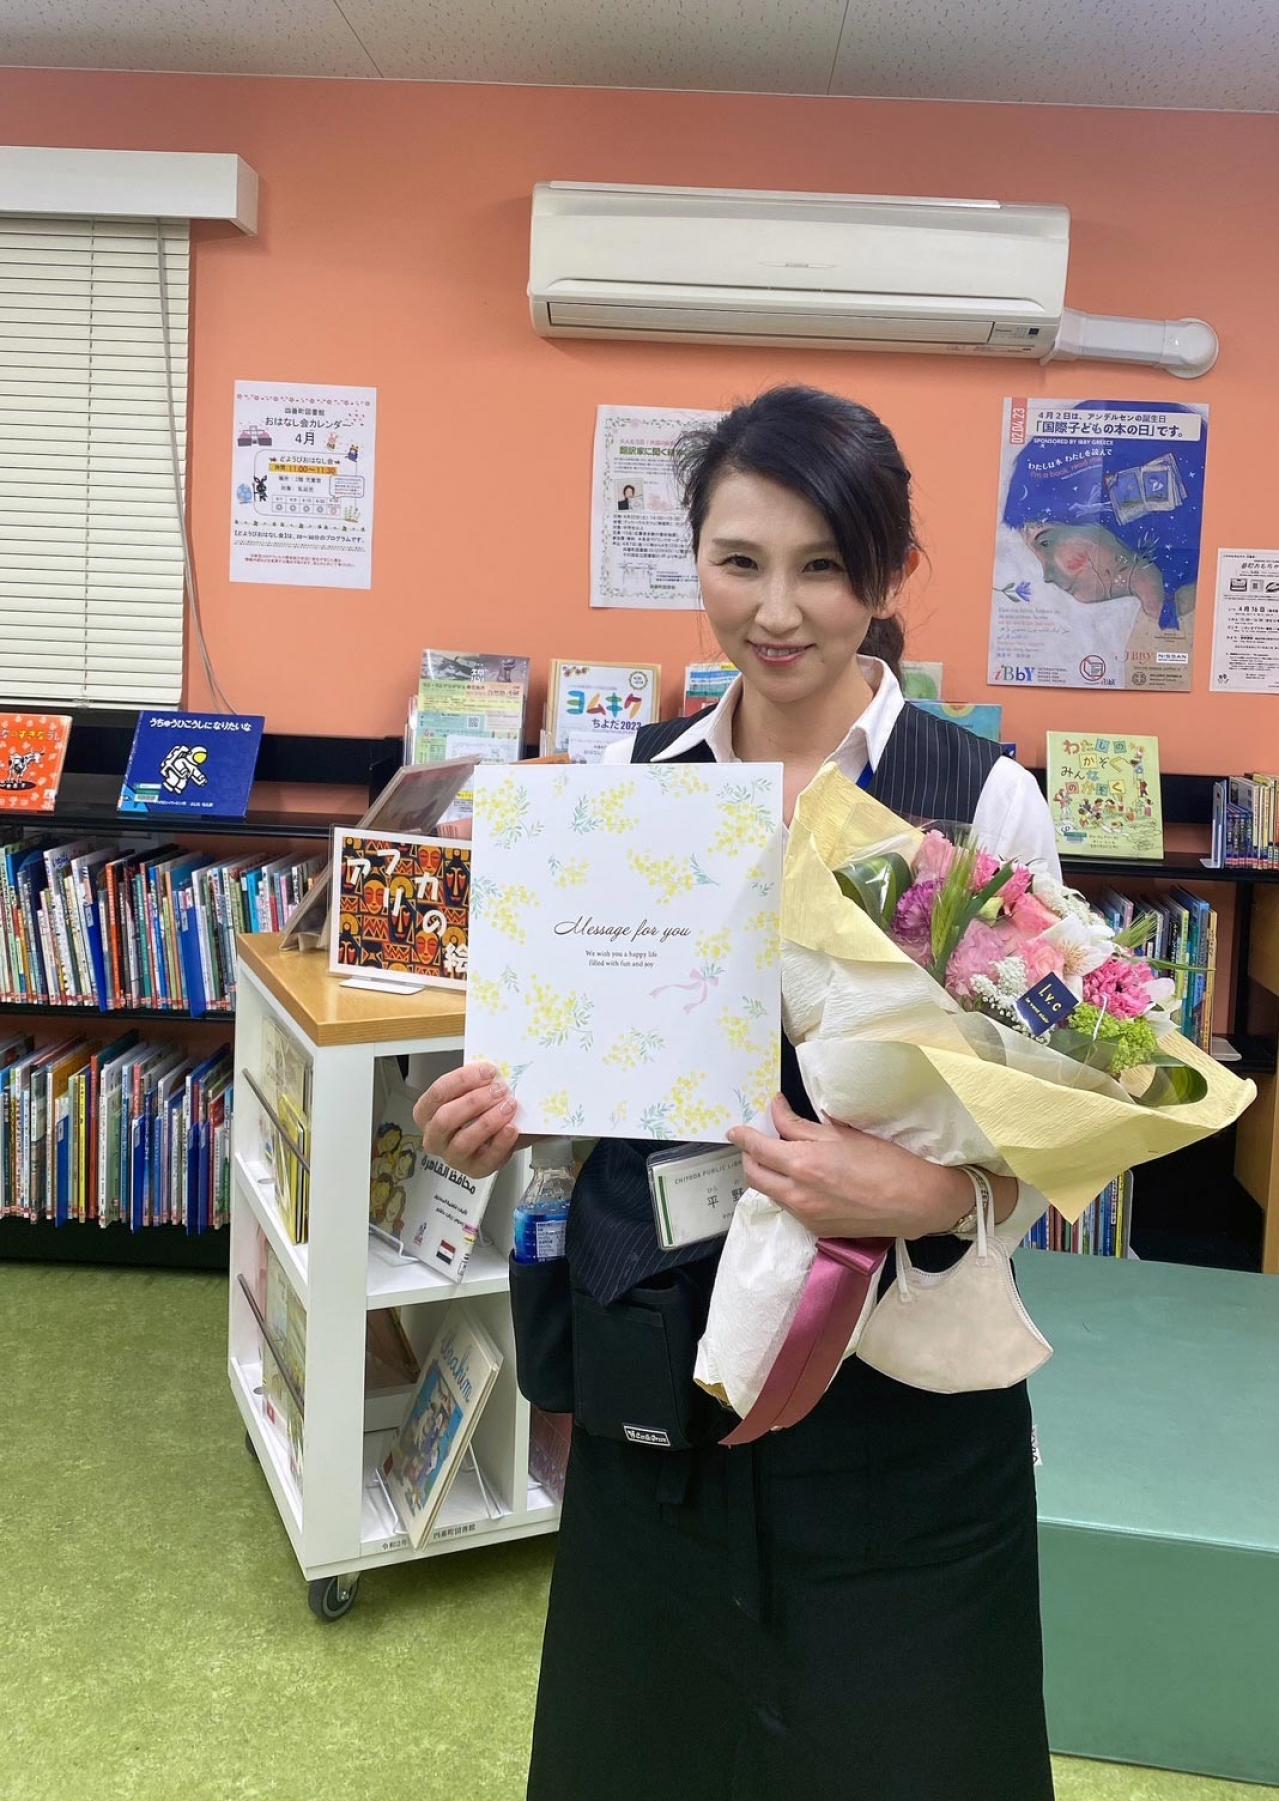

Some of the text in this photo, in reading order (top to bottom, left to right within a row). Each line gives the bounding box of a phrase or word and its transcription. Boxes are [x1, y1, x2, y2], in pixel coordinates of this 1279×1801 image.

[265, 417, 352, 428] おはなし会カレンダー
[1036, 421, 1183, 437] 「国際子どもの本の日」です。
[295, 431, 315, 446] 4月
[567, 690, 642, 720] ヨムキク
[553, 915, 692, 943] Message for you
[612, 951, 623, 959] you
[629, 951, 647, 959] happy
[702, 1165, 726, 1176] PUBLIC
